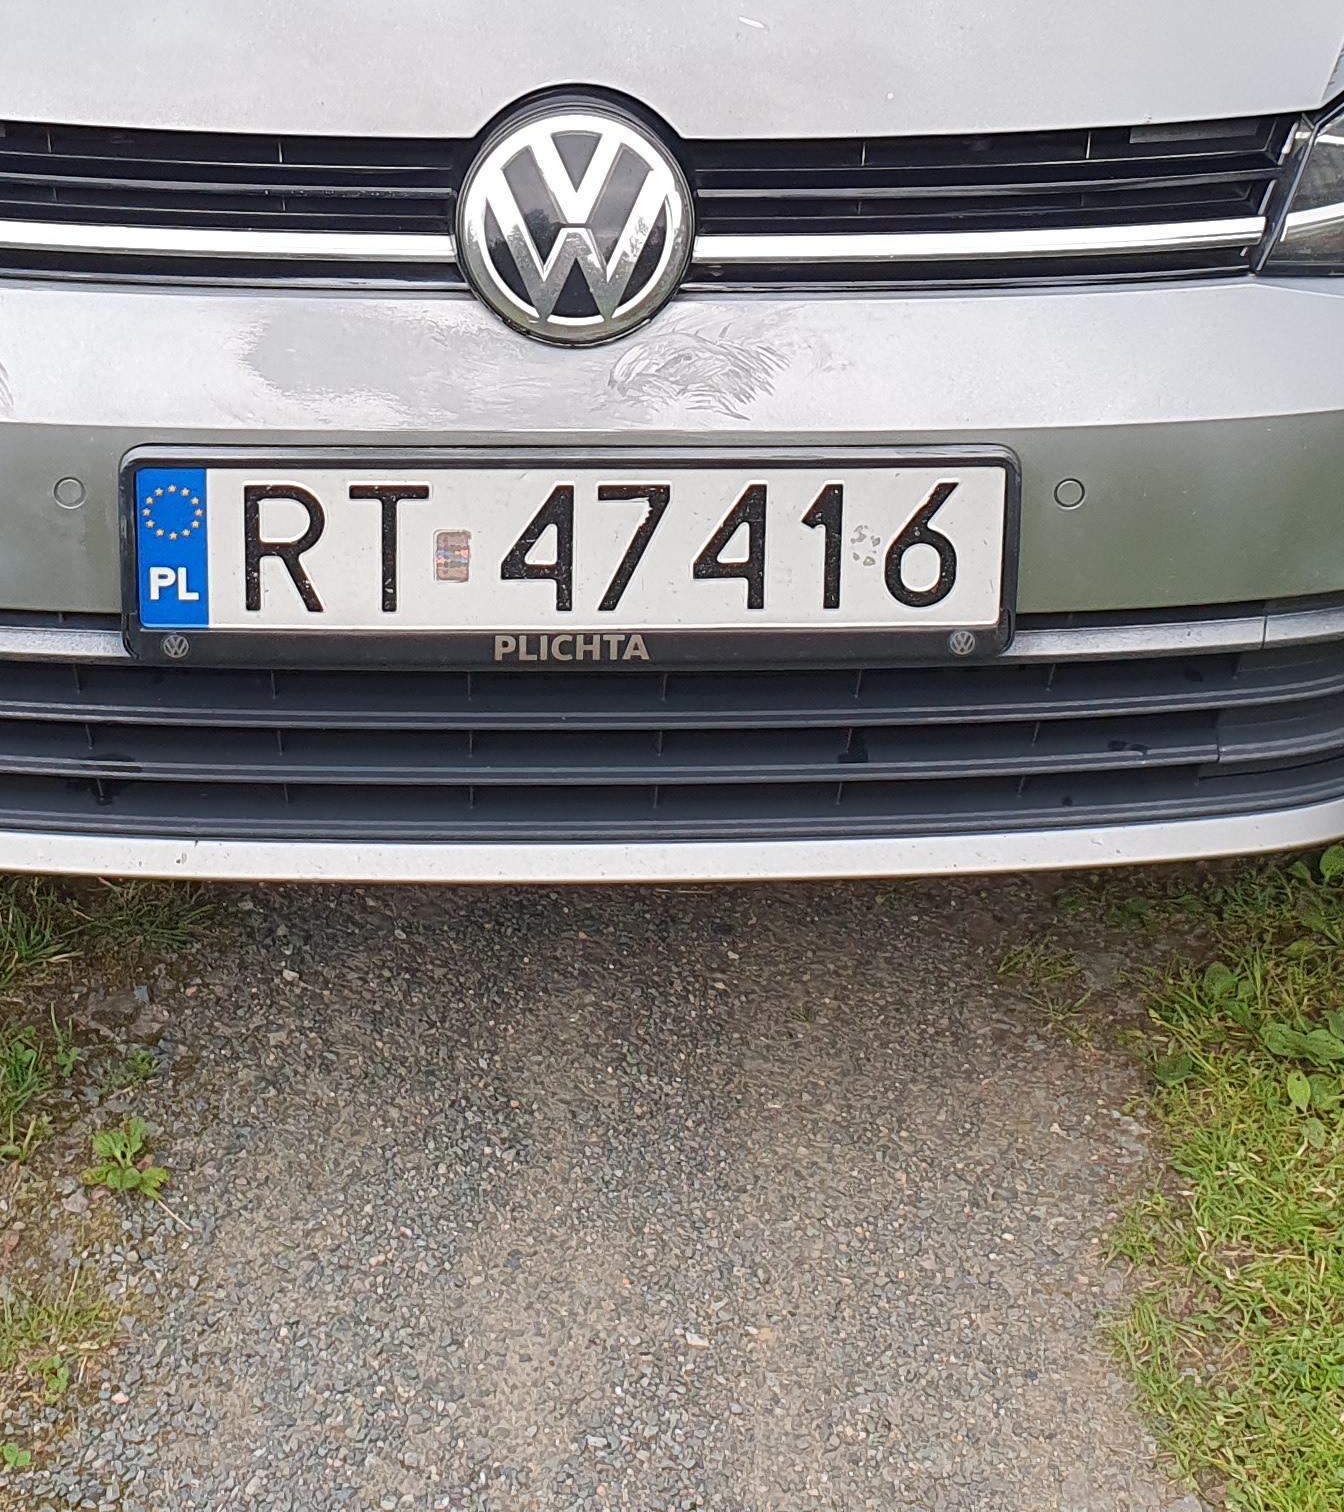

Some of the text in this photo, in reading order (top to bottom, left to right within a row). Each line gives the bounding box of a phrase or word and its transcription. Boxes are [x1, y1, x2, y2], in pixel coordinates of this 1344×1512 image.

[464, 114, 686, 338] VW
[243, 481, 960, 613] RT 47416
[149, 566, 200, 601] PL
[164, 634, 189, 658] VW
[494, 634, 650, 662] PLICHTA
[950, 631, 975, 655] VW
